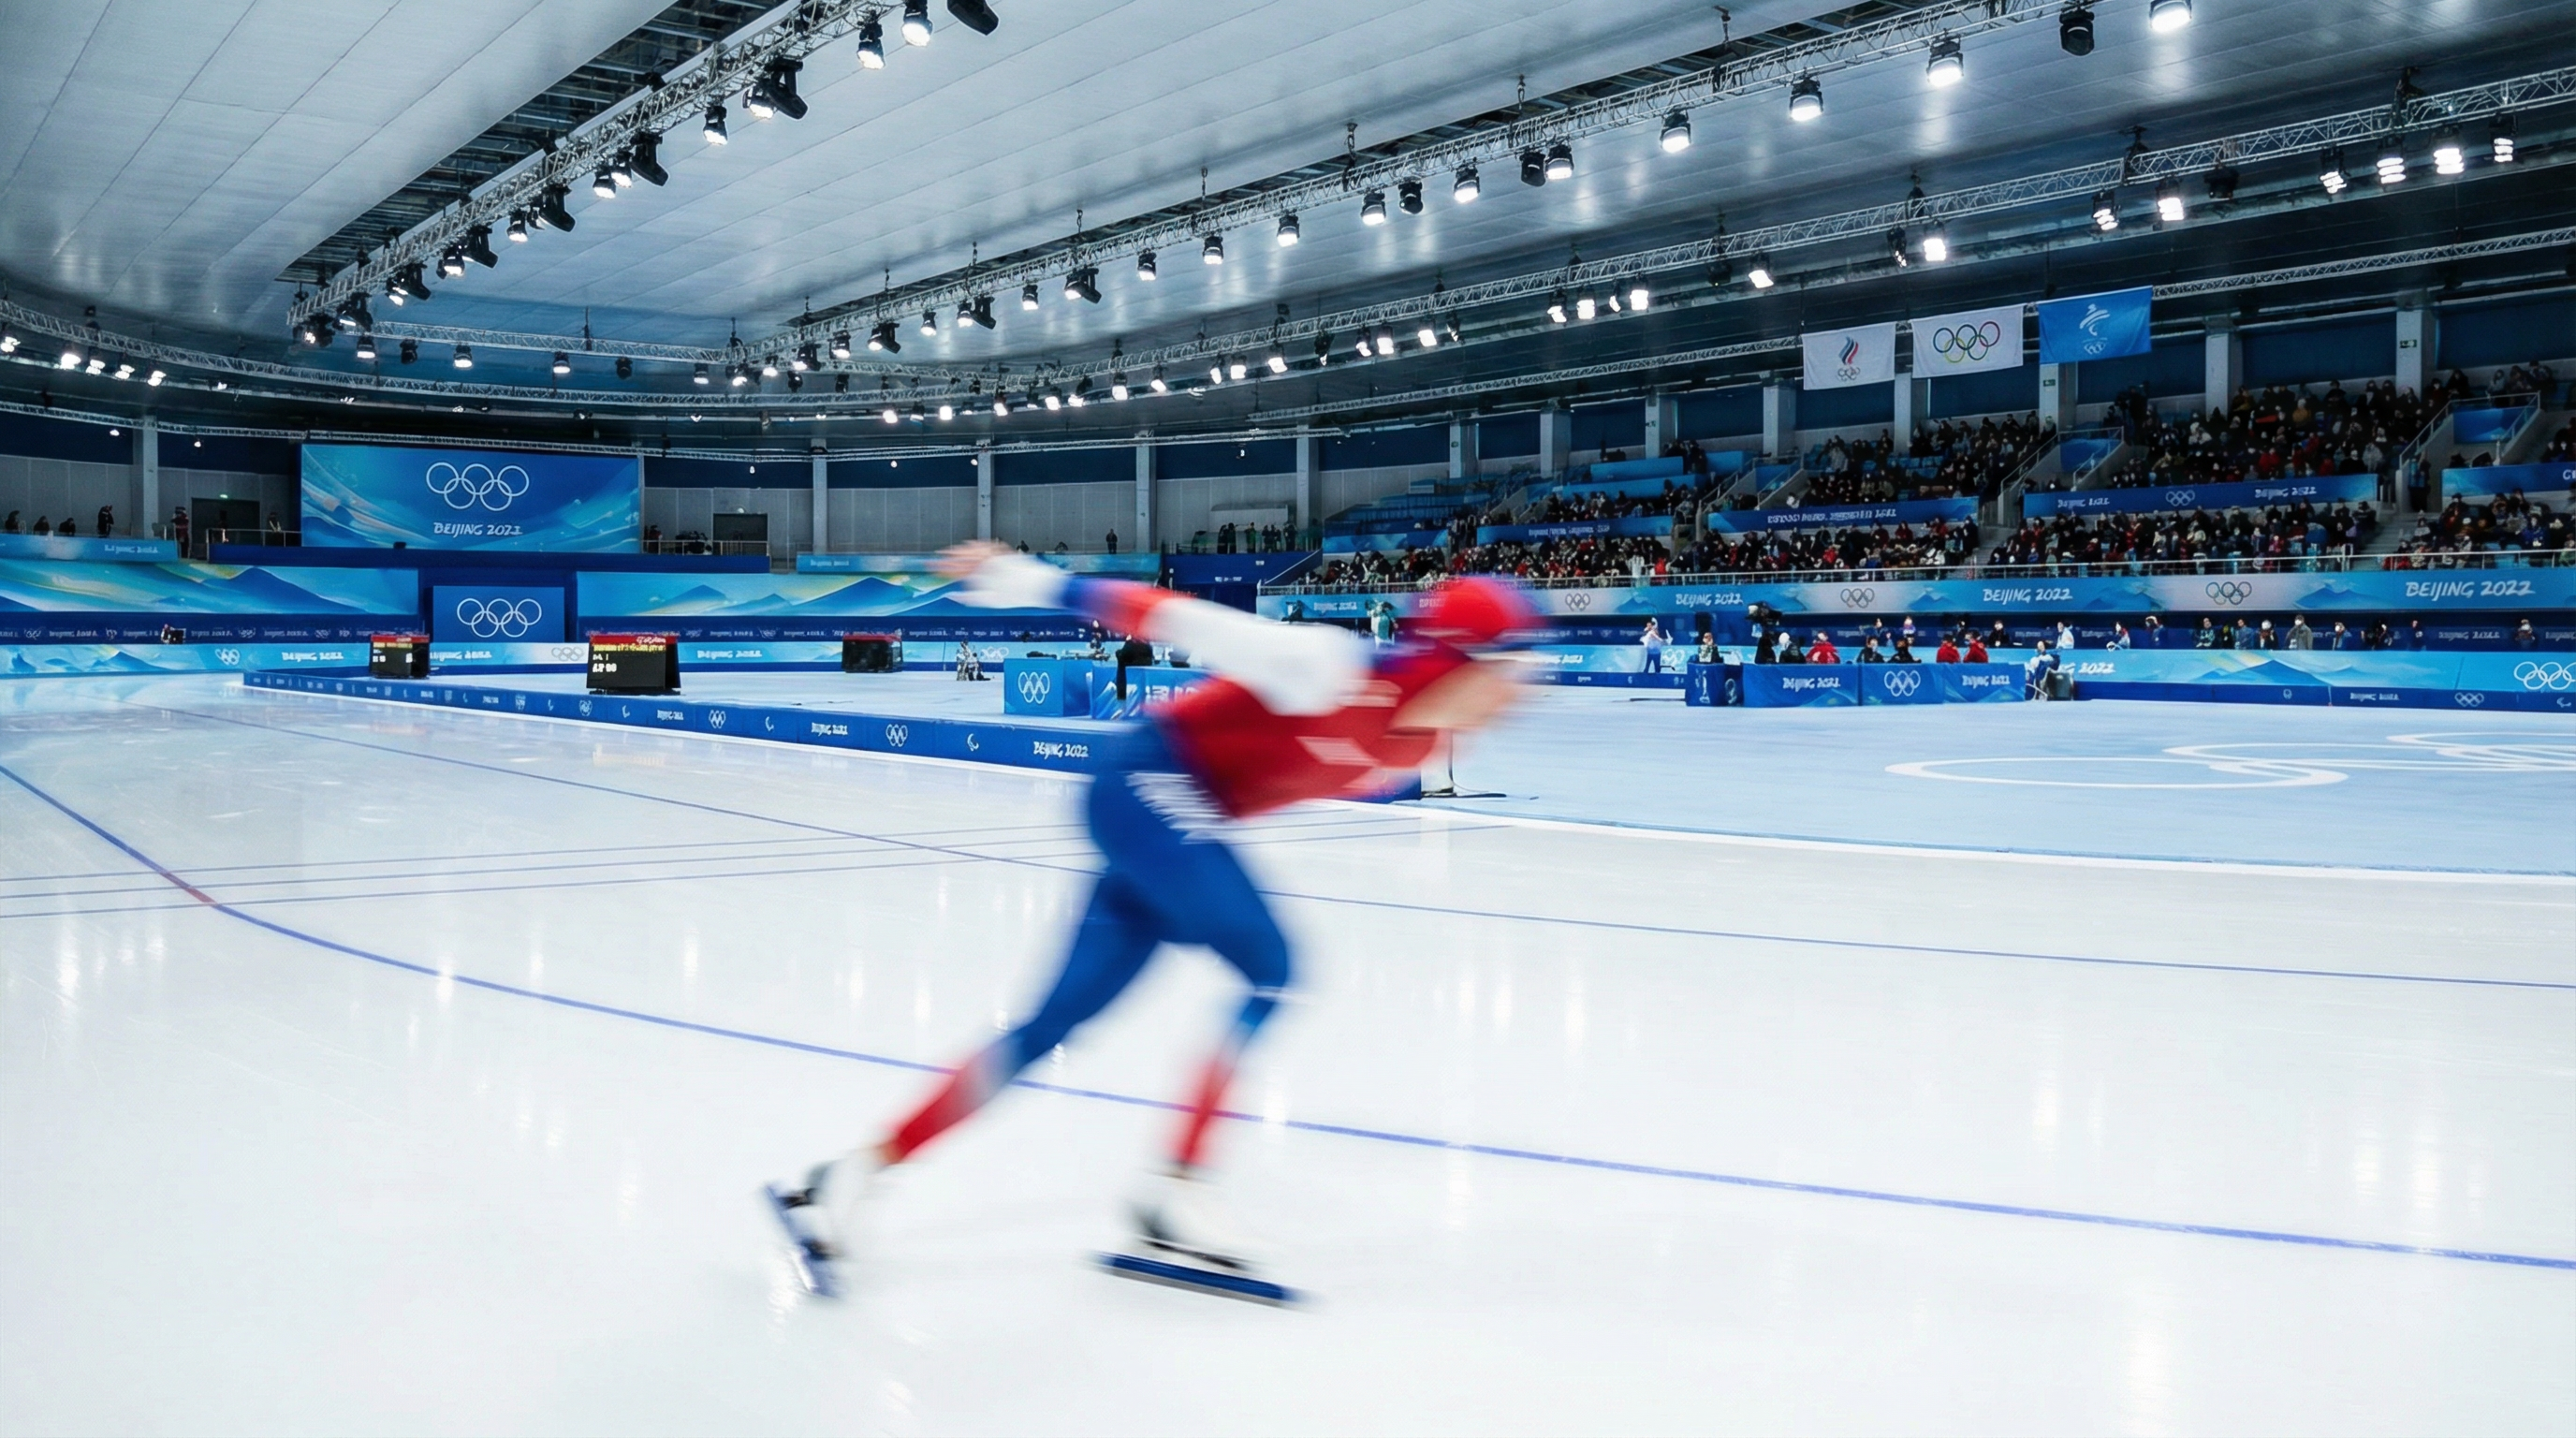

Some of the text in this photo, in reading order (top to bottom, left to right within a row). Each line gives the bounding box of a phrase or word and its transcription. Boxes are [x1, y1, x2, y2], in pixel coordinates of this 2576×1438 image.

[433, 522, 483, 538] BEIJING
[1983, 587, 2073, 606] BEIJING 2022
[2406, 580, 2536, 601] BEIJING 2022
